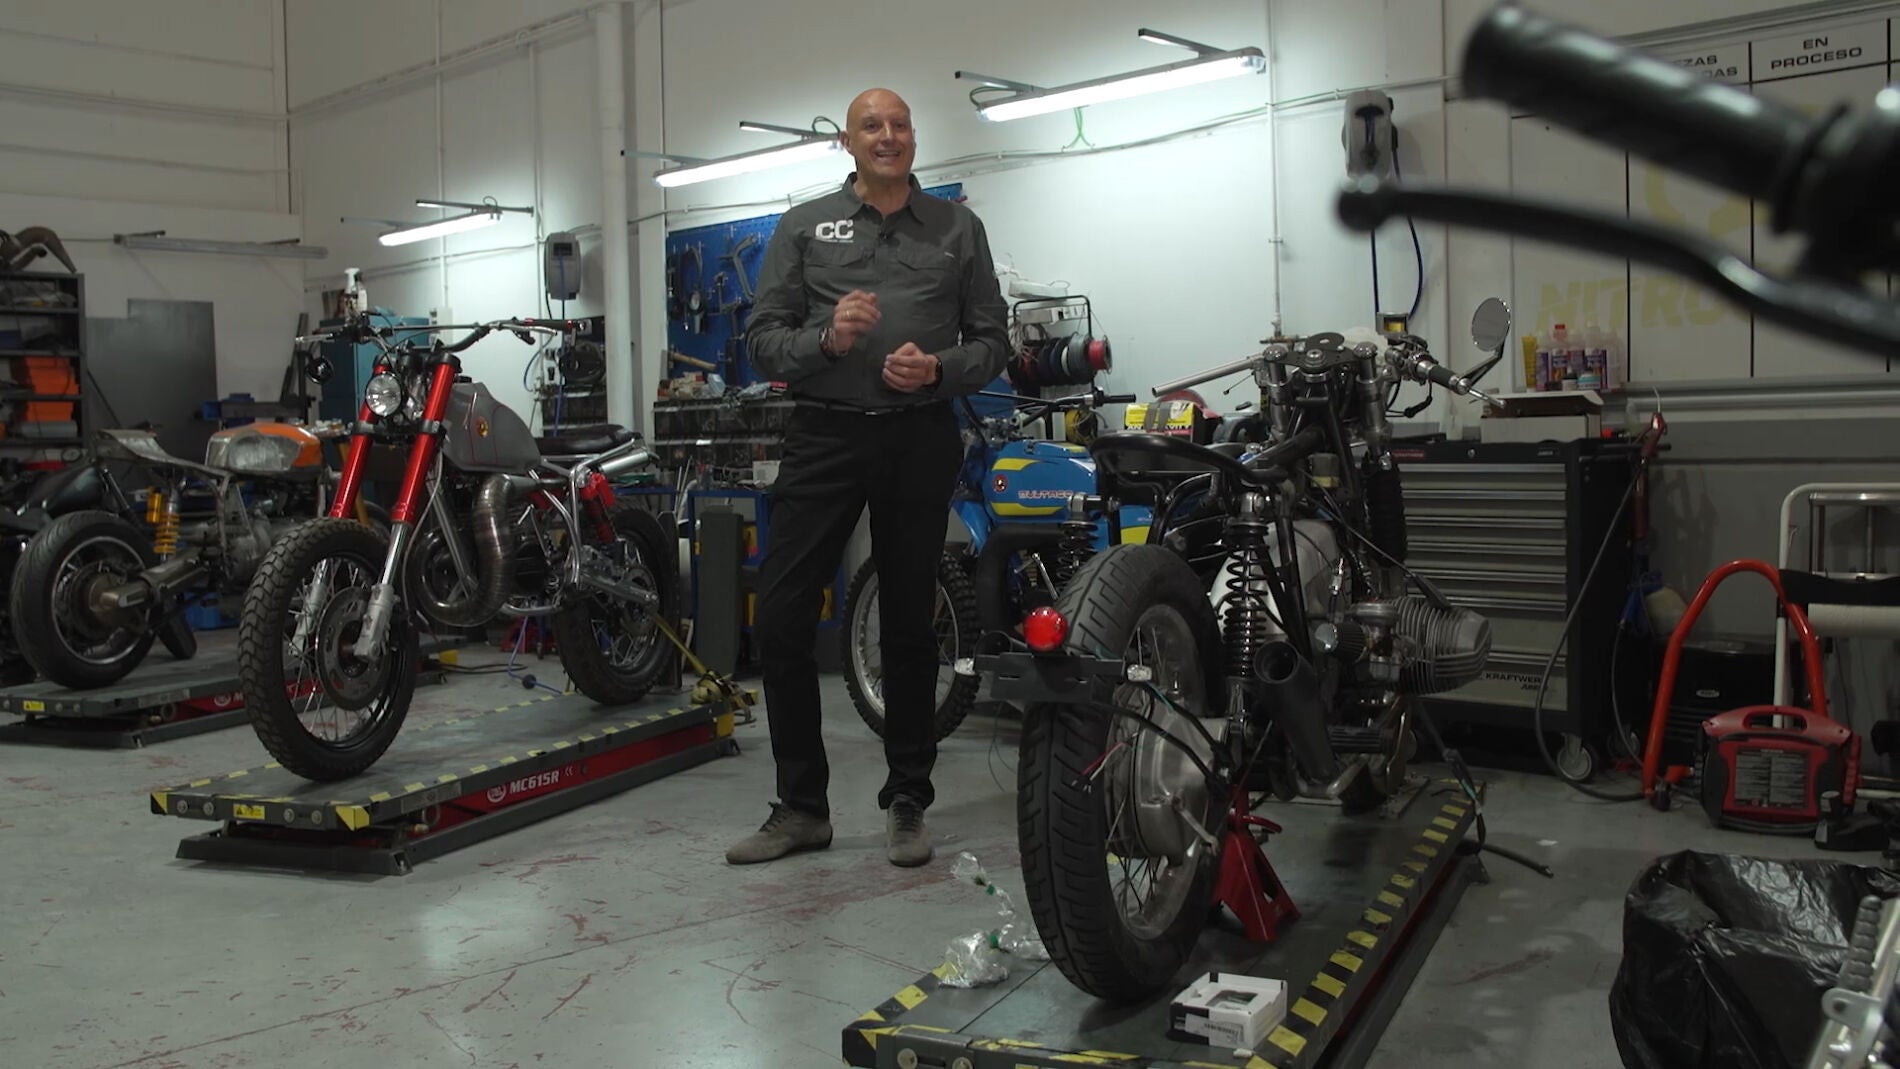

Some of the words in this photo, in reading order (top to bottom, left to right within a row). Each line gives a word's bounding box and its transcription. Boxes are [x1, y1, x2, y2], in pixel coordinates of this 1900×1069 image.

[1803, 36, 1828, 50] EN
[1771, 47, 1862, 70] PROCESO
[815, 219, 854, 239] CC
[509, 770, 559, 794] MC615R
